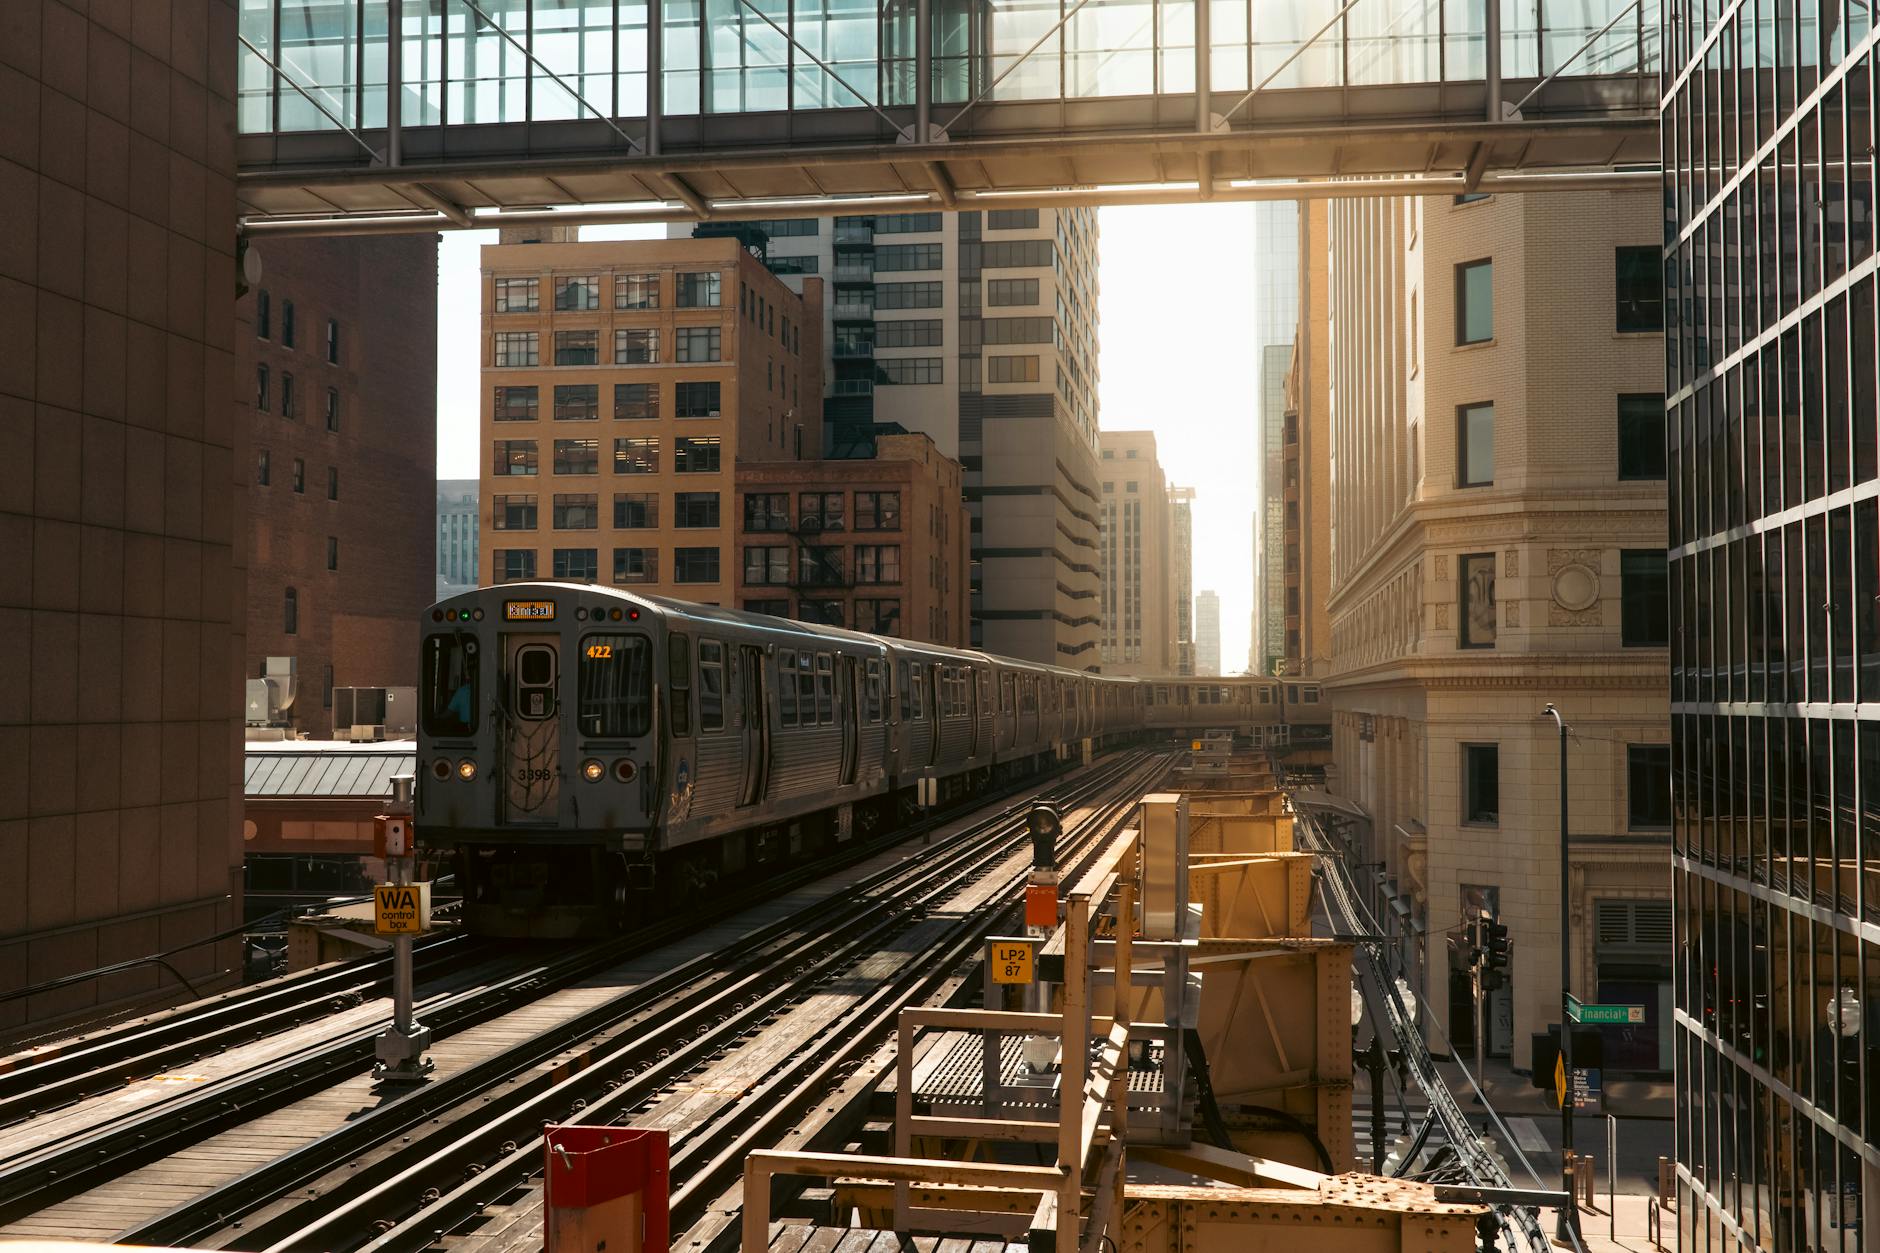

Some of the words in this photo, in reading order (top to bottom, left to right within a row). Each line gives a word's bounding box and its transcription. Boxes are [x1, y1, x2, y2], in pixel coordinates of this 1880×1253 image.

[586, 645, 612, 658] 422
[518, 769, 551, 781] 3398
[380, 891, 416, 909] WA
[381, 910, 415, 920] control
[389, 920, 408, 929] box
[1000, 949, 1026, 961] LP2
[1005, 965, 1021, 977] 87
